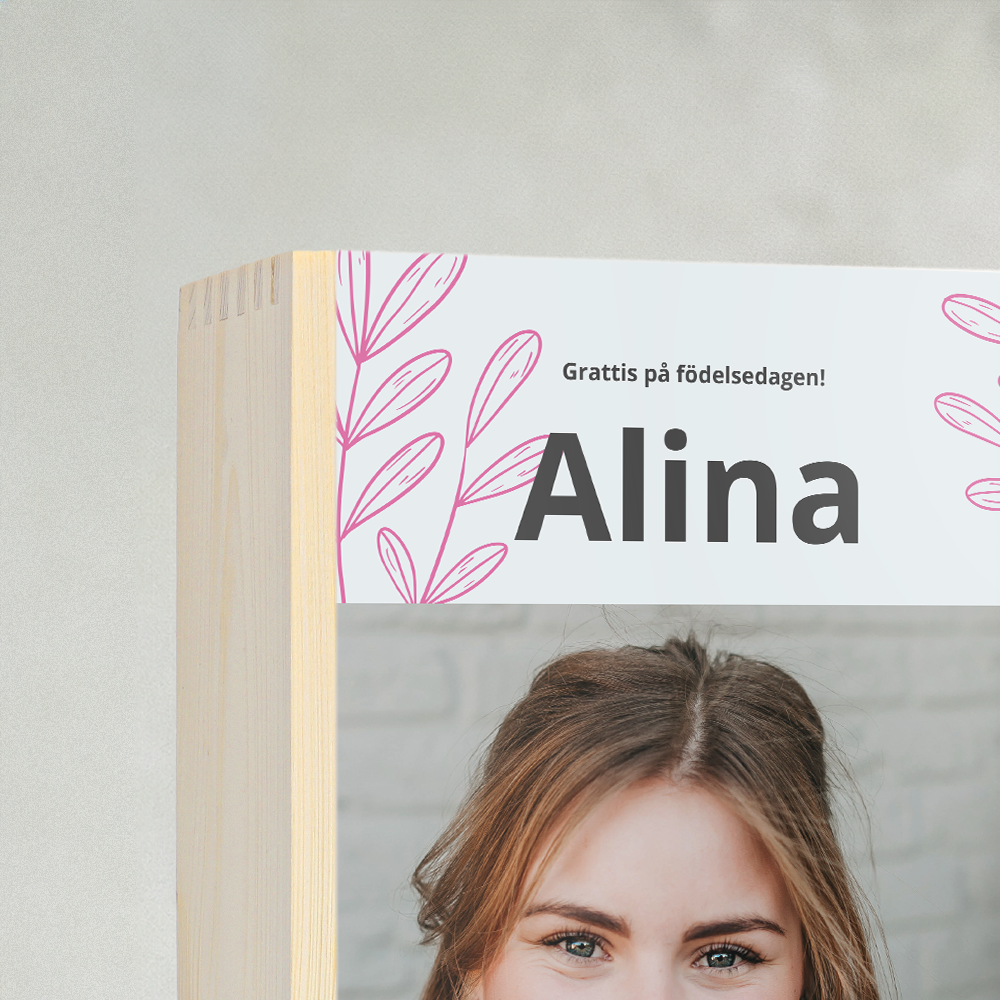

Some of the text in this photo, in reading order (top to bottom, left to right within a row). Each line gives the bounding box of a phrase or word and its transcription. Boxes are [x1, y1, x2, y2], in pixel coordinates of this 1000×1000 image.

[562, 361, 826, 392] Grattis på födelsedagen!
[514, 426, 860, 546] Alina
